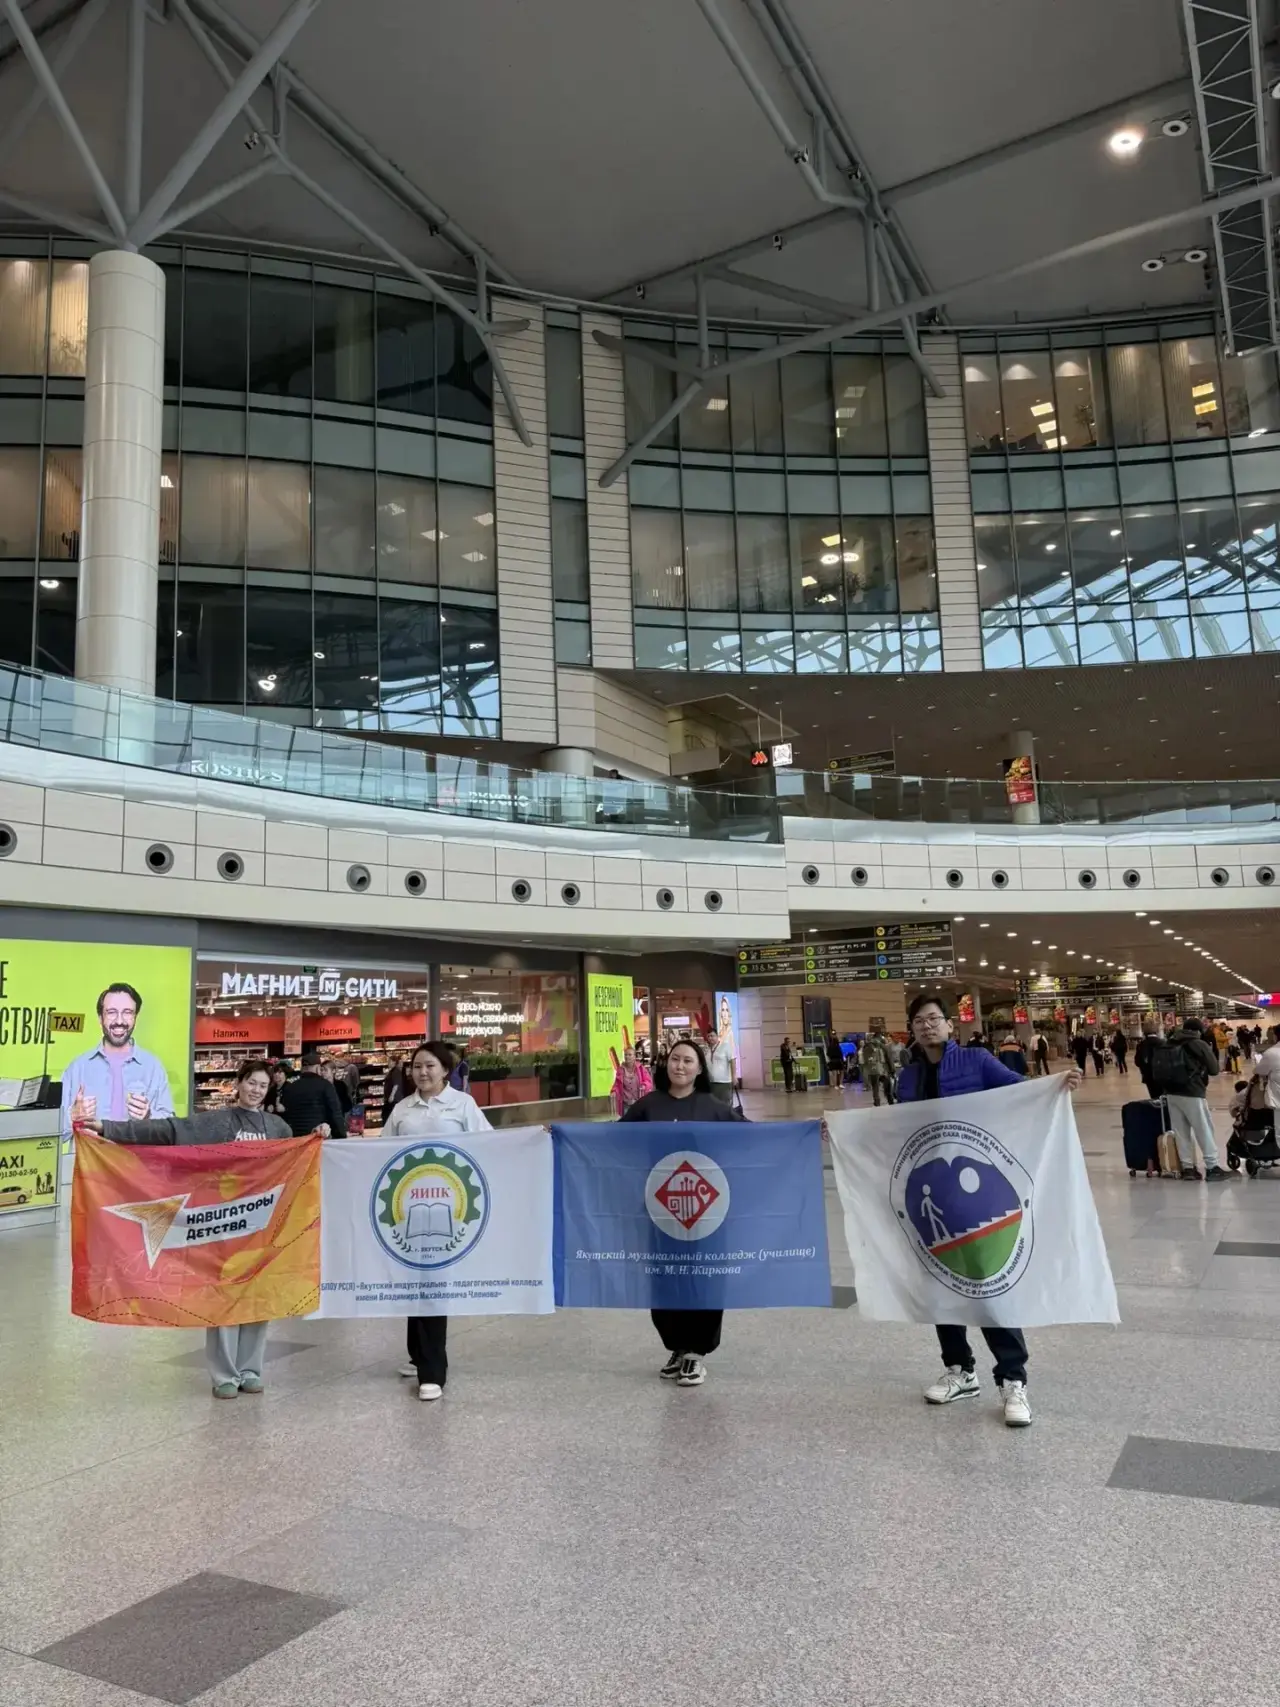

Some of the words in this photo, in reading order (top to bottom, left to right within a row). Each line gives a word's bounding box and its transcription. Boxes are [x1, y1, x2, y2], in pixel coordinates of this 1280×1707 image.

[221, 972, 314, 997] МАГНИТ
[345, 977, 398, 999] СИТИ
[54, 1016, 81, 1031] TAXI
[319, 1027, 353, 1036] Напитки
[212, 1028, 249, 1039] Напитки
[989, 1140, 1014, 1167] НАУКИ
[410, 1187, 451, 1200] ЯИПК
[186, 1193, 275, 1225] НАВИГАТОРЫ
[186, 1219, 247, 1241] ДЕТСТВА
[575, 1248, 625, 1263] Якутский
[627, 1250, 702, 1262] музыкальный
[704, 1249, 756, 1261] колледж
[758, 1246, 816, 1261] (училище)
[691, 1264, 741, 1277] Жиркова
